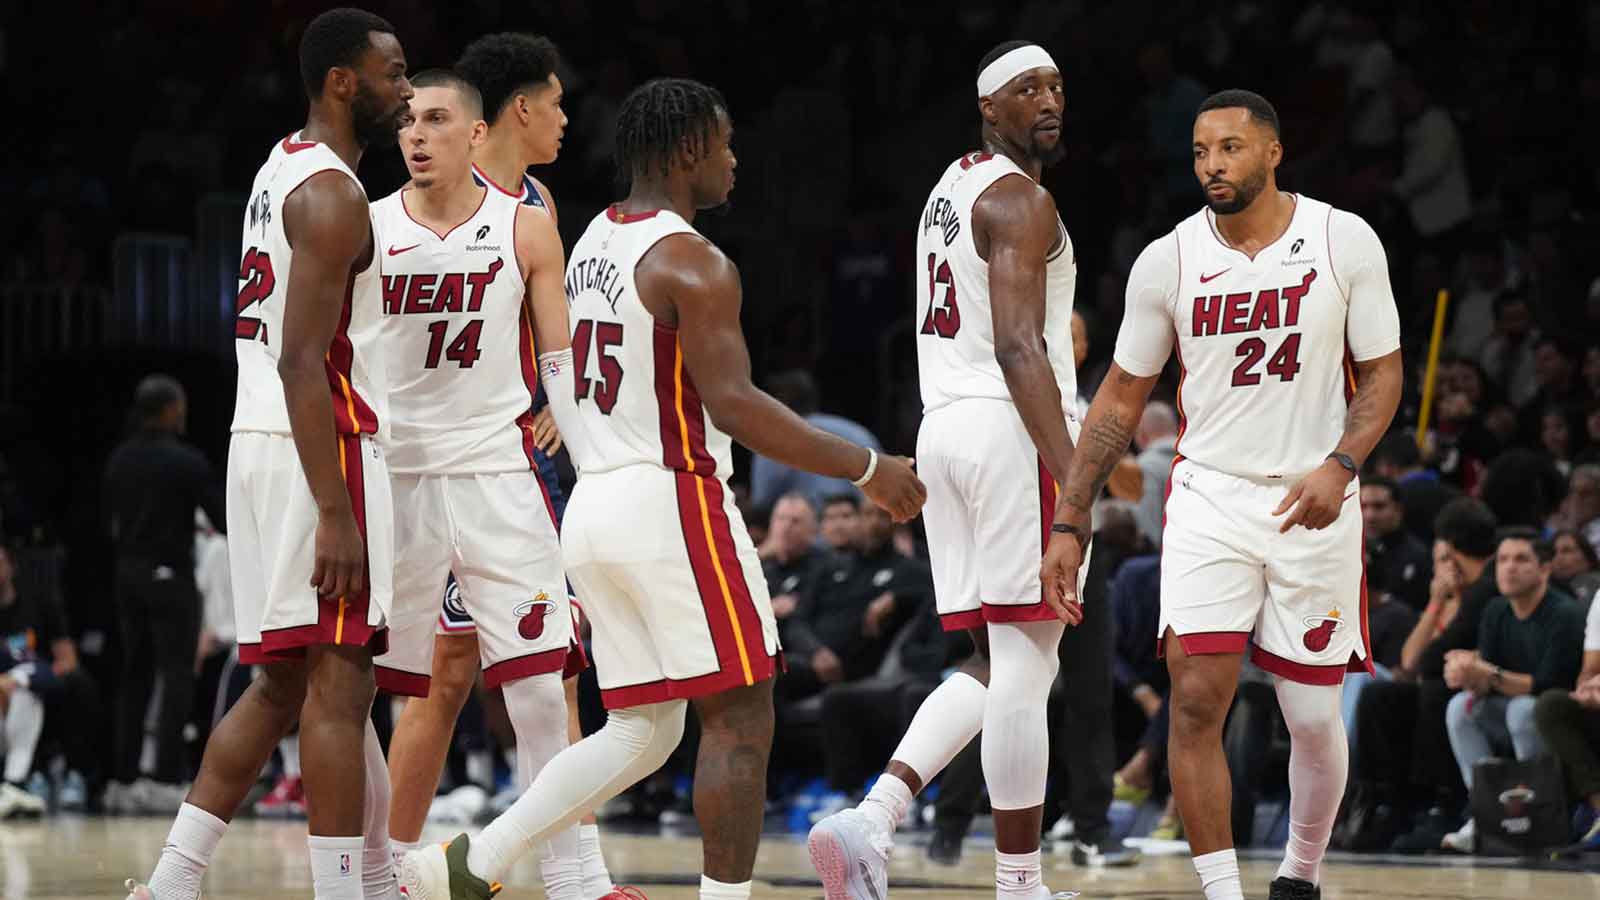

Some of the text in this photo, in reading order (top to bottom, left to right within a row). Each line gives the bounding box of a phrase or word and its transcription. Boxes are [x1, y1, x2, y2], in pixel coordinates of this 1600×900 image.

[381, 256, 504, 314] HEAT
[564, 257, 624, 315] MITCHELL
[920, 253, 961, 339] 13
[1192, 268, 1317, 337] HEAT
[424, 320, 485, 369] 14
[571, 319, 624, 416] 45
[1231, 333, 1302, 387] 24
